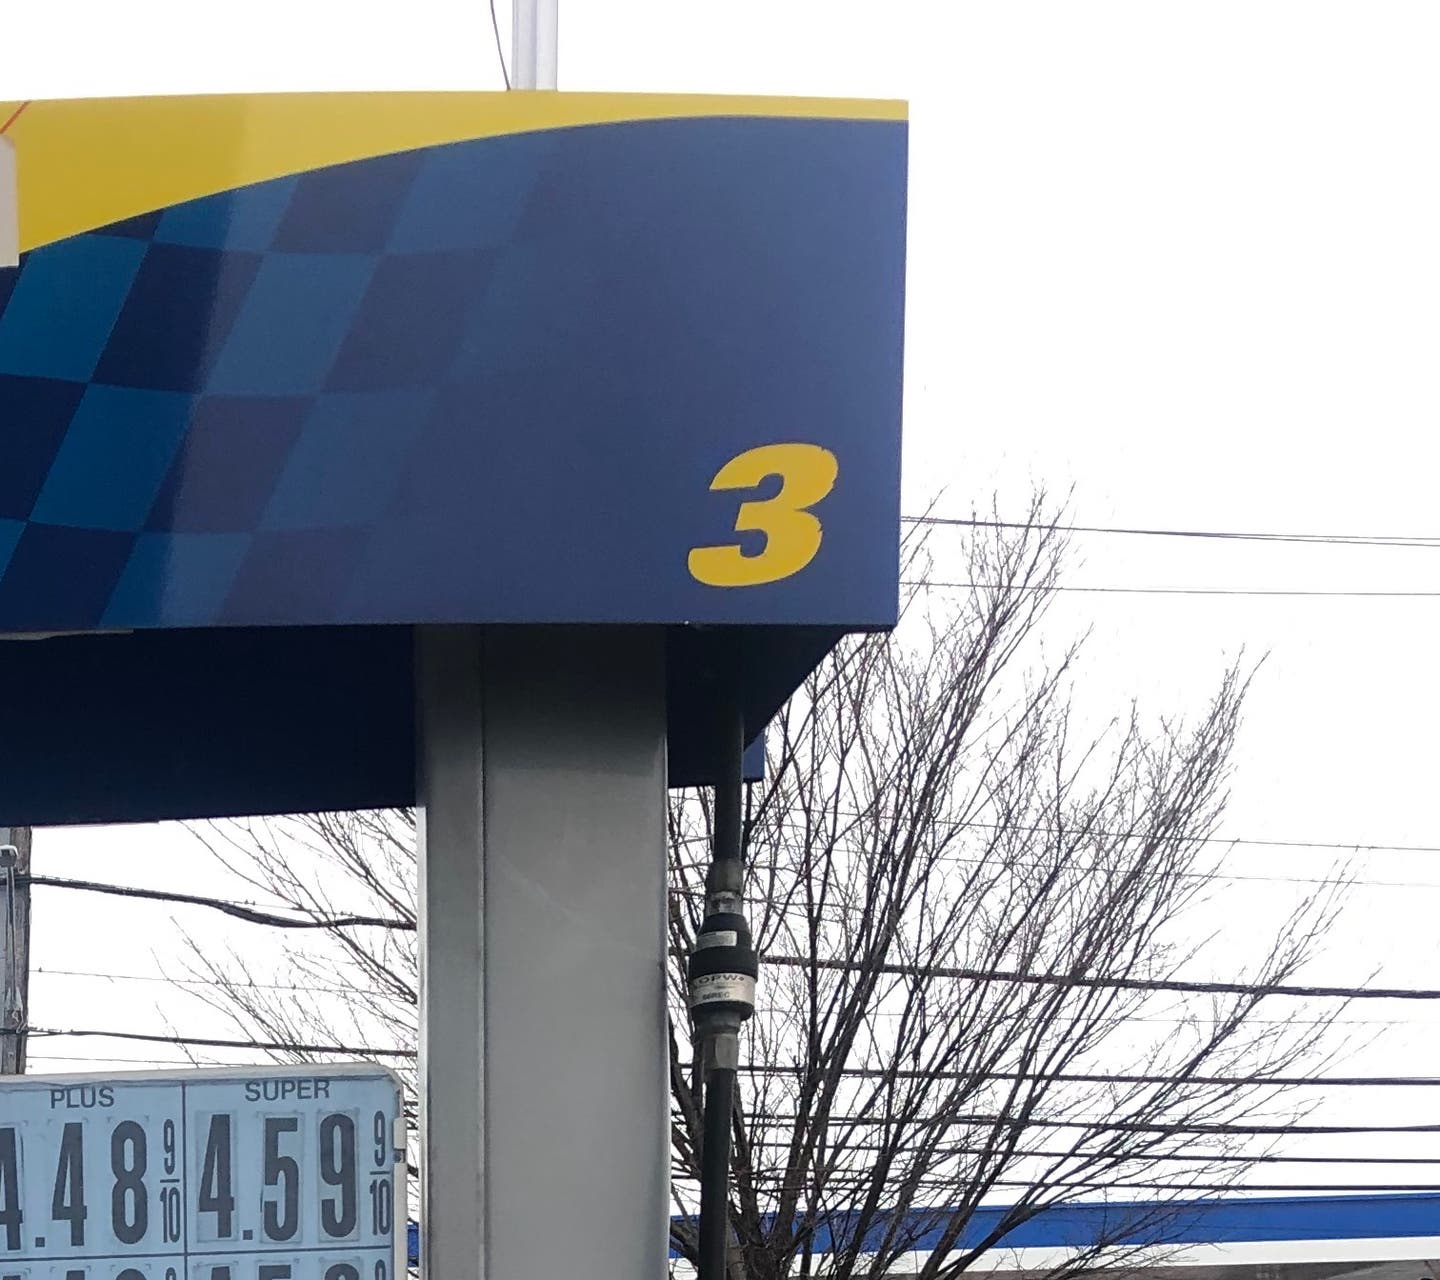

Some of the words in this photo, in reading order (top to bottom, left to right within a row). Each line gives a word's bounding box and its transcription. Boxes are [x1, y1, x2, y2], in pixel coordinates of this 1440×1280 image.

[687, 442, 839, 587] 3
[50, 1087, 114, 1109] PLUS
[245, 1079, 330, 1102] SUPER
[198, 1113, 357, 1242] 4.59
